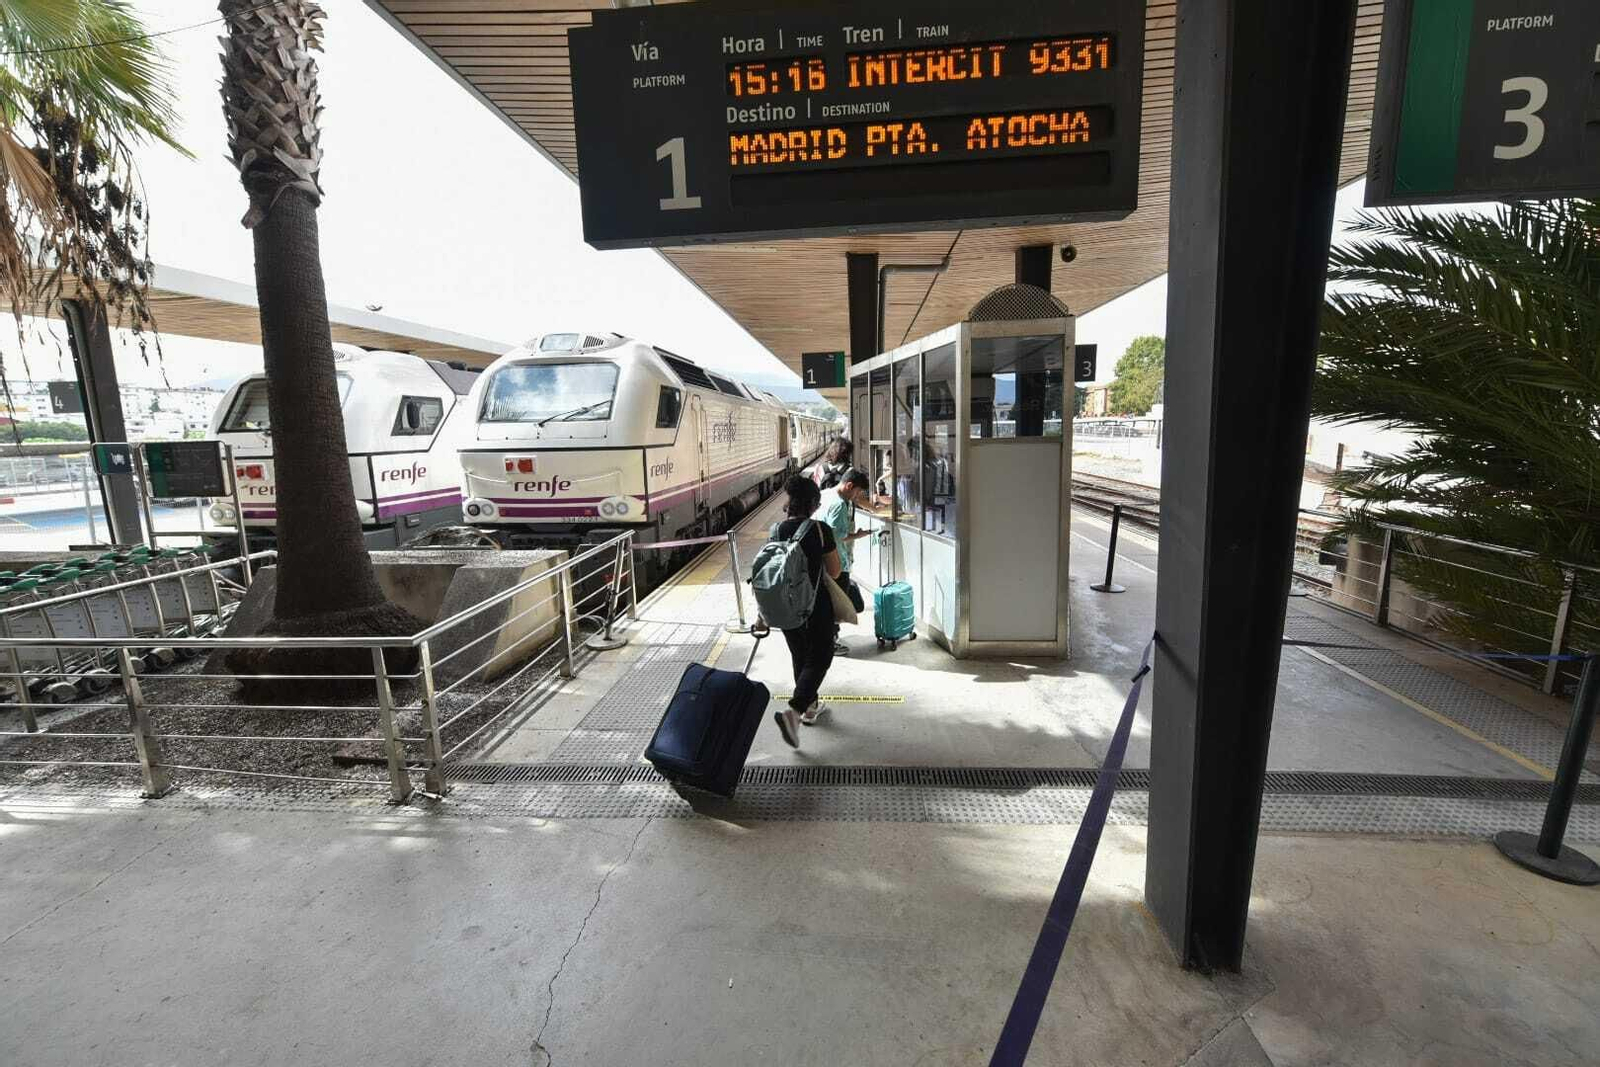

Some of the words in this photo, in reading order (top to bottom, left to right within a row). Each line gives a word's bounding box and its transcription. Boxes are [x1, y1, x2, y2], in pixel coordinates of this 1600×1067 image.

[1487, 15, 1554, 31] PLATFORM
[631, 41, 659, 61] Vía
[722, 36, 765, 54] Hora
[797, 35, 823, 48] TIME
[843, 26, 884, 44] Tren
[917, 25, 949, 38] TRAIN
[729, 59, 826, 97] 15:16
[848, 46, 1006, 88] INTERCIT
[1030, 37, 1109, 74] 9331
[633, 74, 686, 89] PLATFORM
[726, 103, 796, 124] Destino
[822, 101, 891, 117] DESTINATION
[1493, 76, 1549, 160] 3
[730, 127, 847, 166] MADRID
[867, 122, 940, 157] PTA.
[967, 110, 1090, 151] ATOCHA
[656, 137, 702, 211] 1
[806, 368, 817, 385] 1
[1082, 360, 1092, 378] 3
[54, 396, 64, 410] 4
[380, 460, 427, 486] renfe
[650, 456, 674, 482] renfe
[513, 474, 572, 498] renfe
